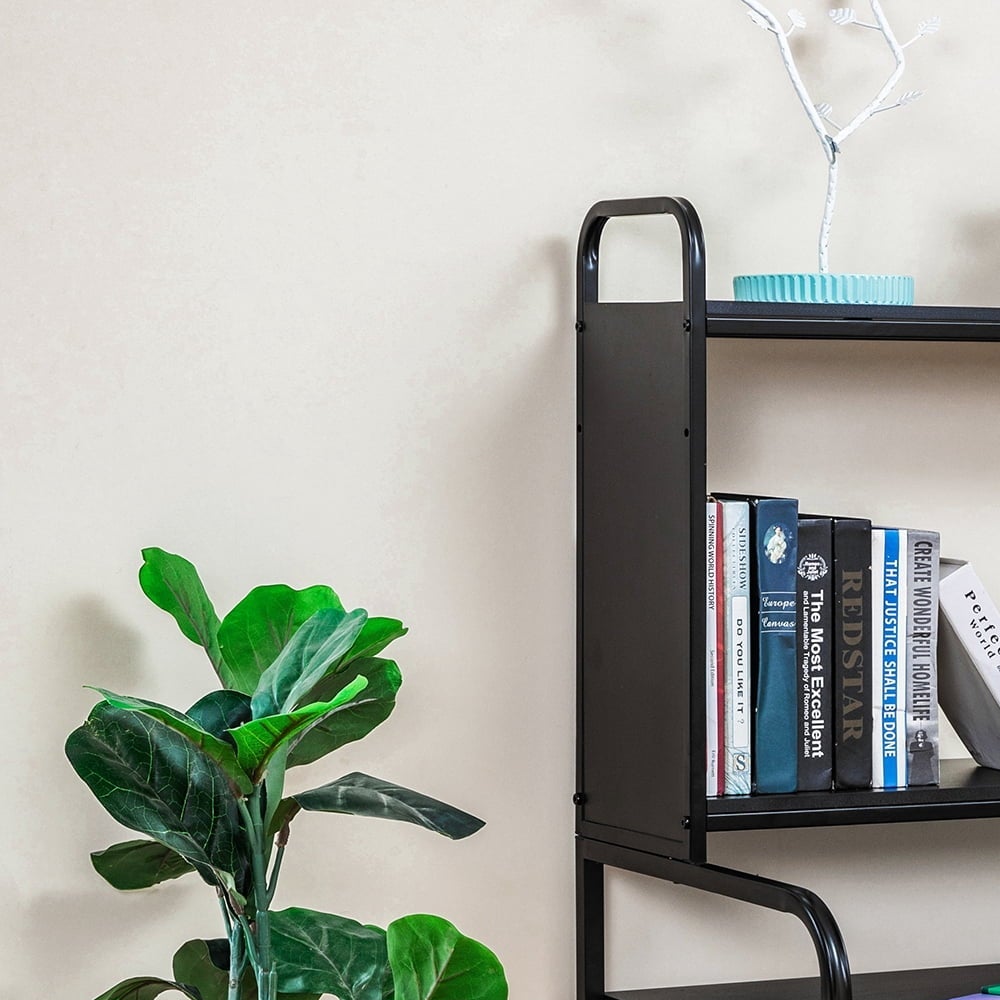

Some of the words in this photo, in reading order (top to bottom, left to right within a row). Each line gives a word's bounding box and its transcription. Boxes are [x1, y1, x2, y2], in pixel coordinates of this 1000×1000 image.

[738, 527, 747, 590] SIDESHOW
[913, 540, 933, 583] CREATE
[885, 560, 898, 596] THAT
[762, 597, 797, 610] Europe
[811, 589, 824, 623] The
[737, 619, 743, 636] DO
[884, 601, 897, 656] JUSTICE
[912, 587, 932, 659] WONDERFUL
[969, 618, 996, 659] World
[802, 651, 810, 683] Tragedy
[811, 628, 824, 672] Most
[842, 570, 864, 743] REDSTAR
[803, 684, 810, 692] of
[884, 660, 897, 701] SHALL
[912, 663, 931, 721] HOMELIFE
[737, 702, 744, 714] IT
[803, 693, 811, 720] Romeo
[811, 676, 825, 758] Excellent
[883, 705, 896, 719] BE
[803, 721, 811, 736] and
[883, 722, 896, 758] DONE
[803, 737, 811, 758] Juliet
